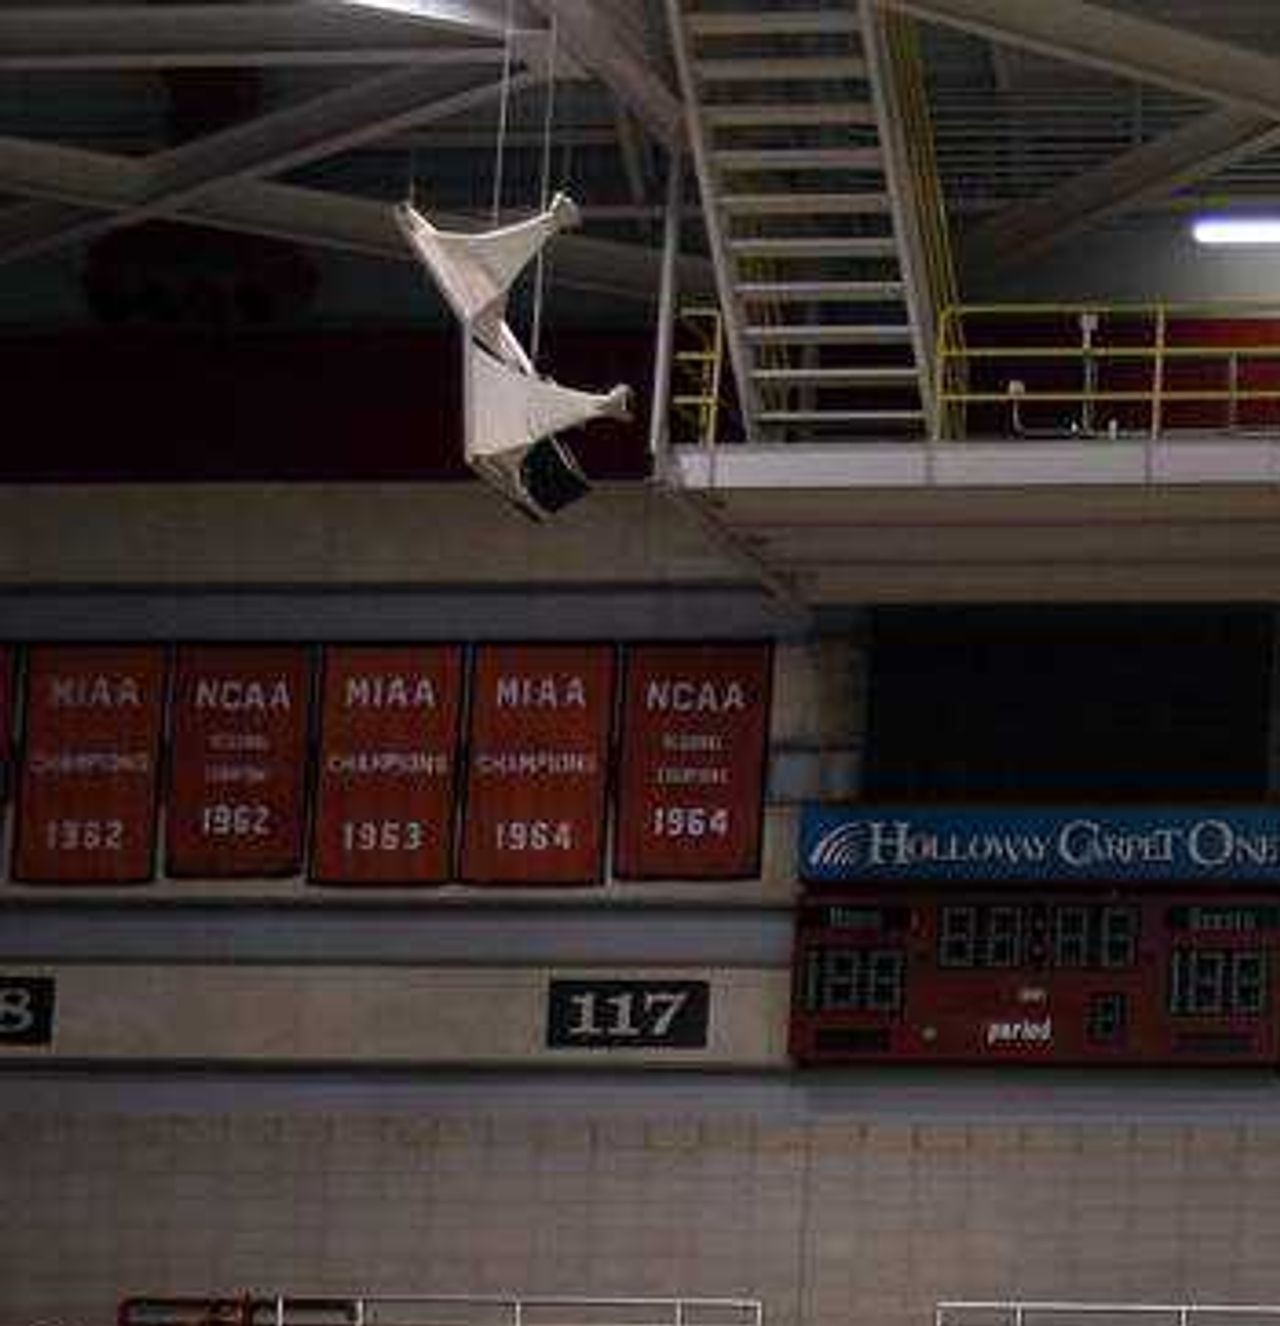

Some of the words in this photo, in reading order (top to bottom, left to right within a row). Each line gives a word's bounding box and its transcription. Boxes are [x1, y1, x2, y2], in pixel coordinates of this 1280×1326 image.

[52, 677, 140, 707] MIAA
[194, 677, 290, 709] NCAA
[345, 677, 436, 707] MIAA
[496, 677, 587, 707] MIAA
[646, 680, 746, 711] NCAA
[202, 806, 271, 836] 1962
[343, 819, 424, 850] 1963
[653, 808, 731, 837] 1964
[566, 990, 689, 1037] 117
[987, 1017, 1053, 1047] period
